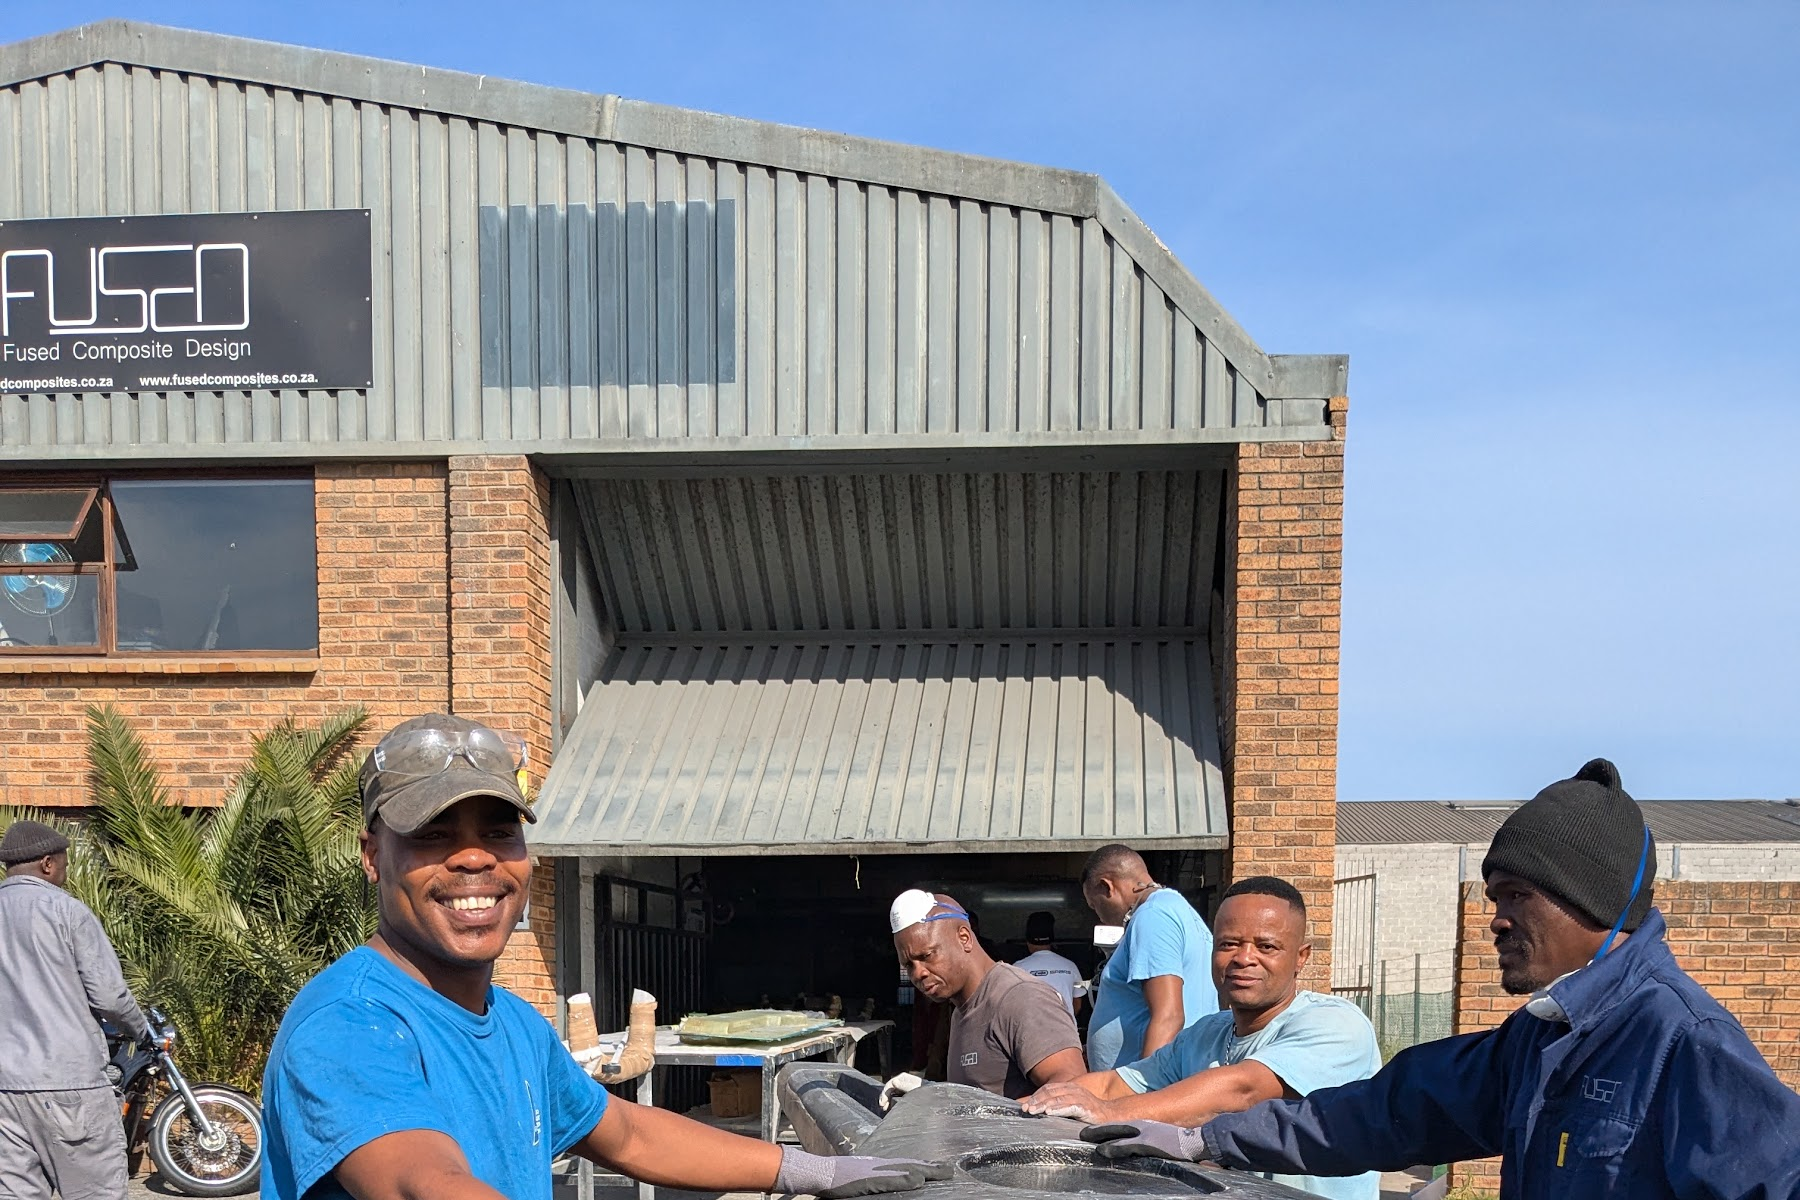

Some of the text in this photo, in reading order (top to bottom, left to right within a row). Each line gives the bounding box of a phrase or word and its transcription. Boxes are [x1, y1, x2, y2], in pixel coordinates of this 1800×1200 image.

[3, 338, 251, 364] Fused Composite Design
[139, 372, 319, 387] www.fusedcomposites.co.za.
